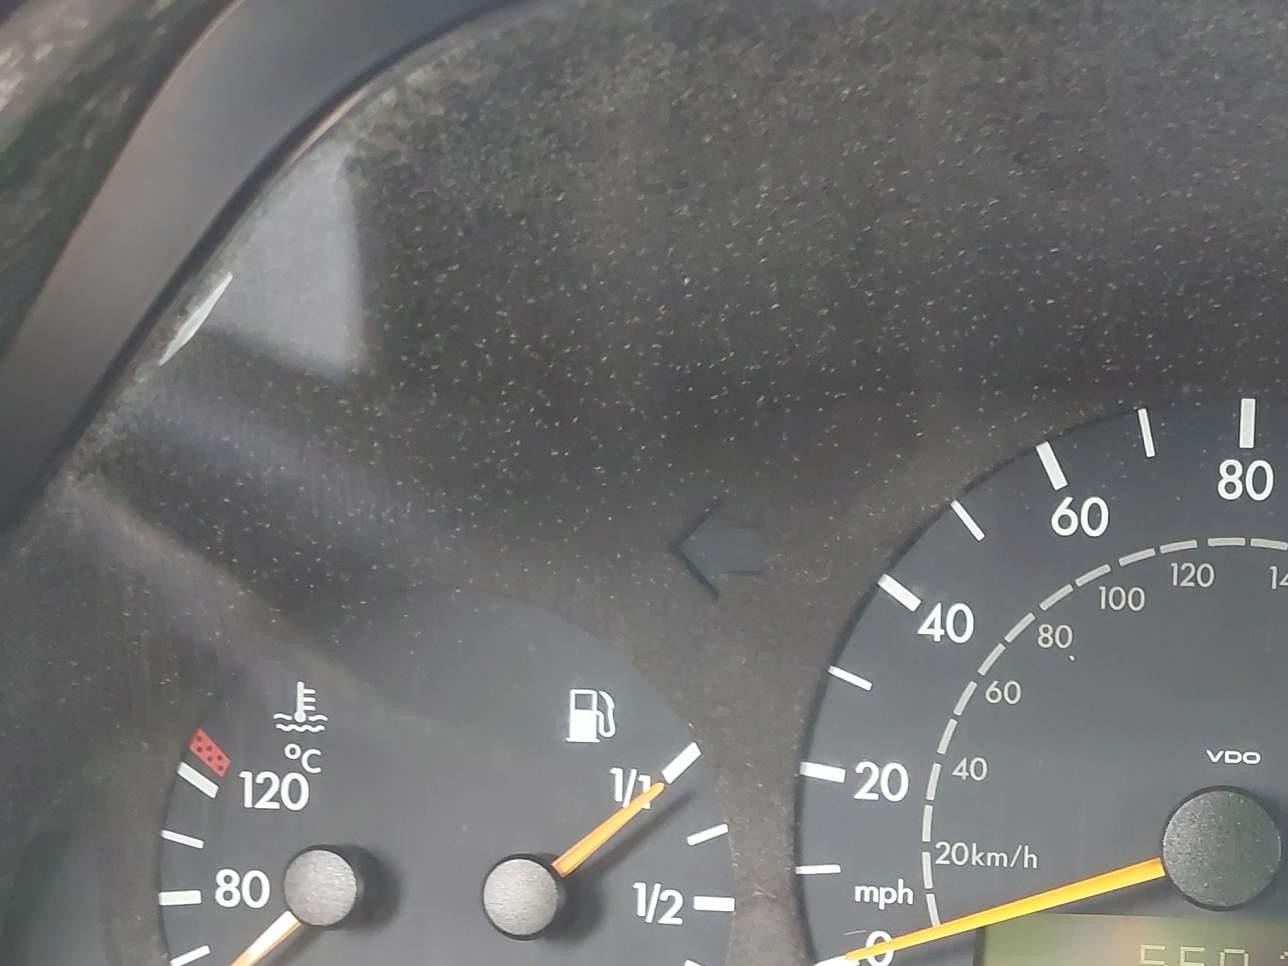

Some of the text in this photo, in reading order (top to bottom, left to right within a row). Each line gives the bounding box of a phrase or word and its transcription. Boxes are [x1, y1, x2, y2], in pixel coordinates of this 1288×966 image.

[1217, 459, 1274, 500] 80
[1051, 497, 1109, 537] 60
[1170, 562, 1215, 588] 120
[1098, 586, 1145, 612] 100
[917, 603, 974, 644] 40
[1037, 624, 1073, 649] 80
[985, 680, 1022, 705] 60
[952, 757, 988, 782] 40
[1206, 749, 1261, 766] VDO
[239, 771, 310, 811] 120
[854, 761, 910, 802] 20
[214, 869, 271, 909] 80
[632, 882, 684, 925] 1/2
[854, 878, 914, 910] mph
